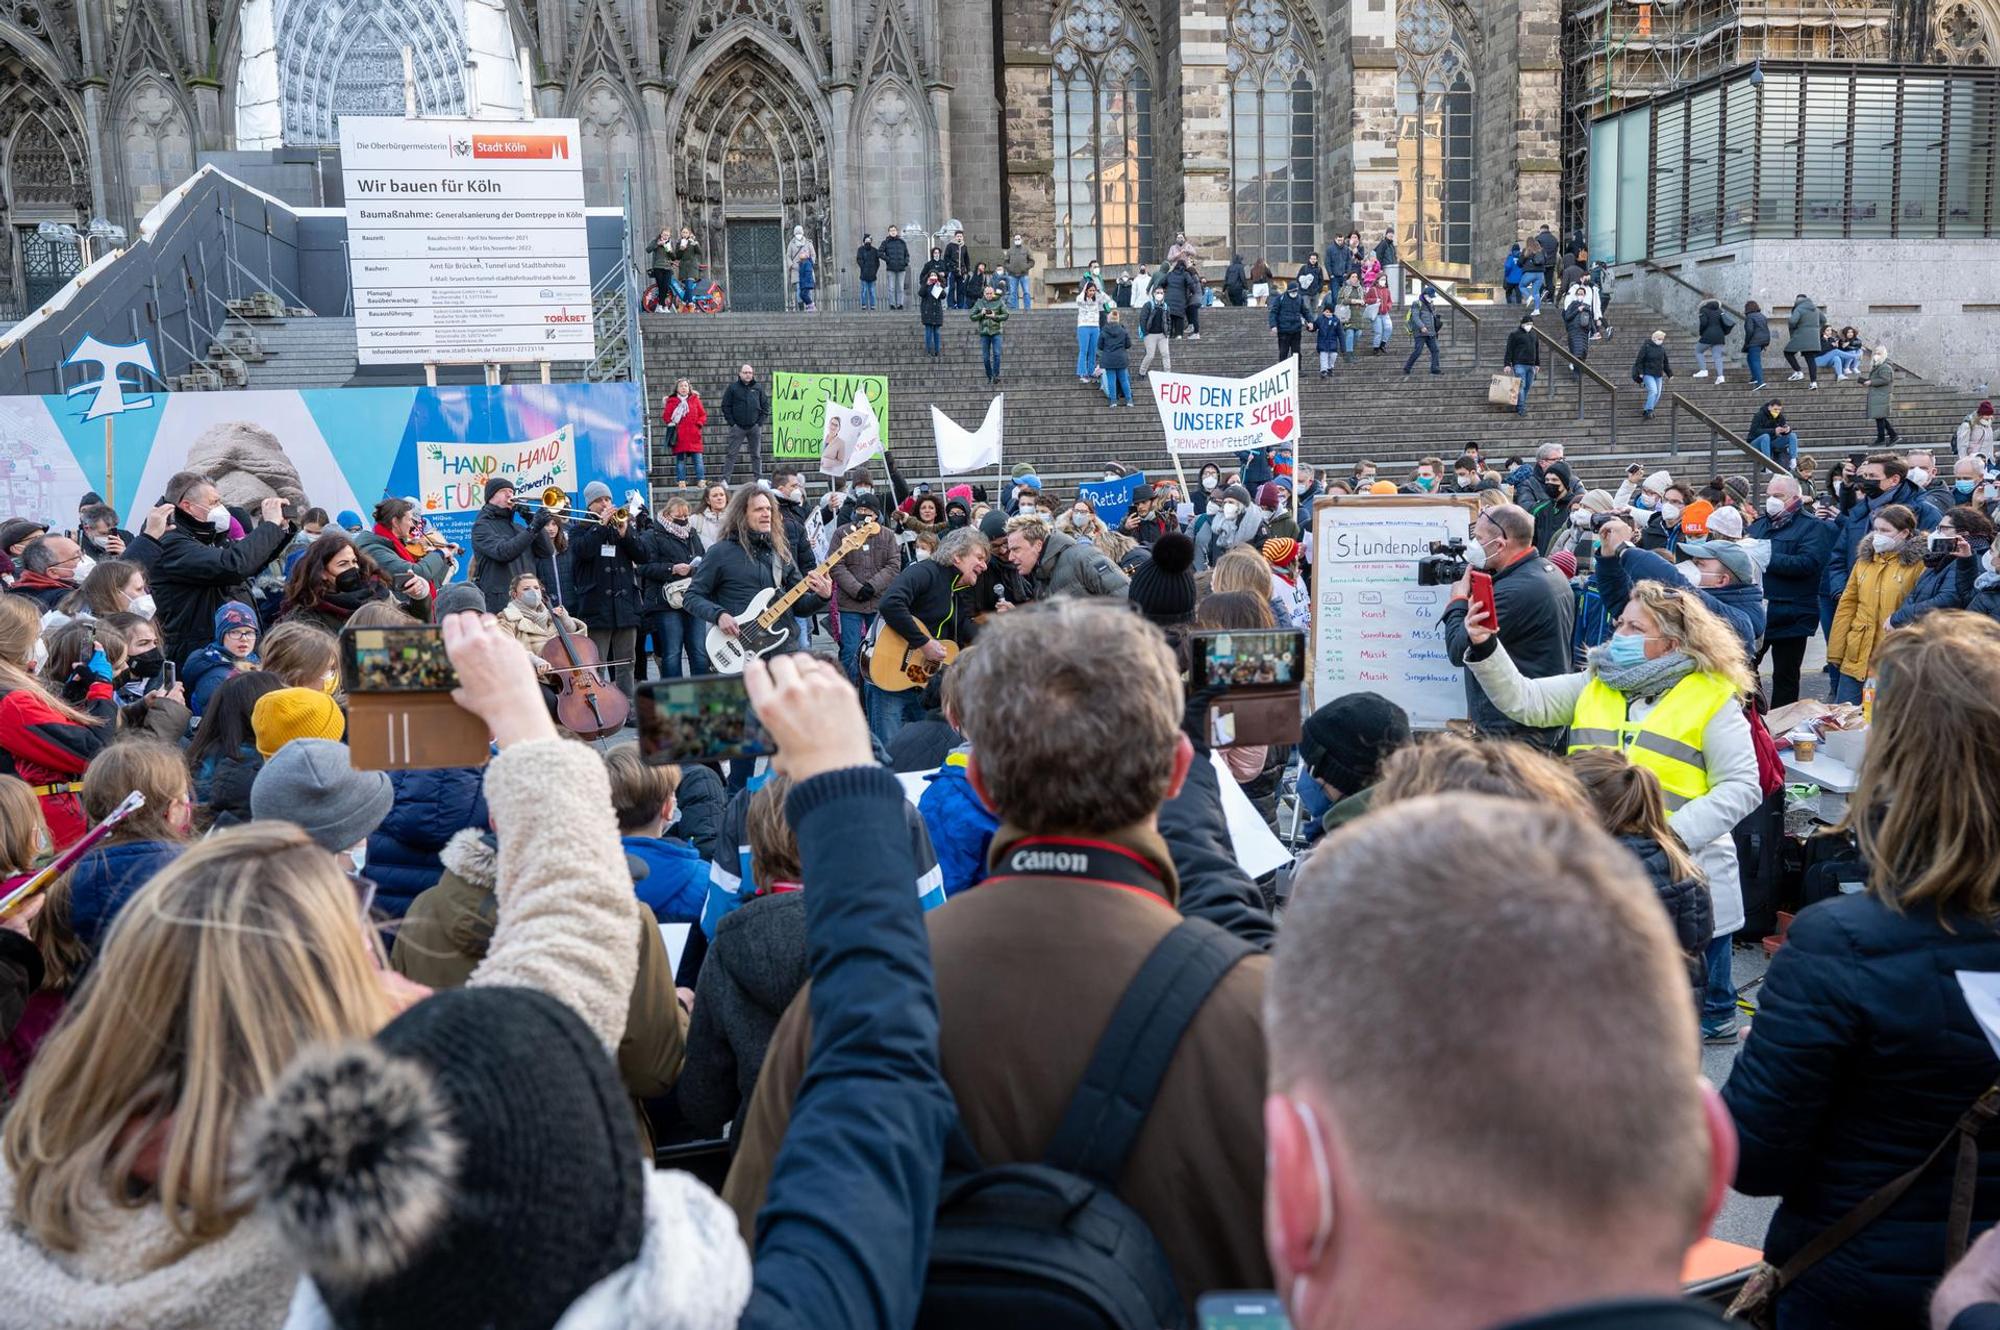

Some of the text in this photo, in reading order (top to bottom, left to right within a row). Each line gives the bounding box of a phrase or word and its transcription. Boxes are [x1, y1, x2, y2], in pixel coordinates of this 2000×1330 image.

[356, 142, 447, 152] Die Oberbürgermeisterin
[477, 142, 527, 153] Stadt Köln
[358, 179, 501, 193] Wir bauen für Köln
[360, 210, 583, 221] Baumaßnahme: Generalsanierung der Domtreppe in Köln
[455, 262, 484, 270] Brücken,
[544, 311, 586, 323] TORKRET
[1161, 369, 1291, 408] FÜR DEN ERHALT
[779, 404, 804, 422] und
[1173, 411, 1244, 431] UNSERER
[443, 440, 560, 475] HAND in HAND
[444, 482, 481, 510] FÜR
[1336, 533, 1430, 559] Stundenpla
[1011, 850, 1088, 872] Canon
